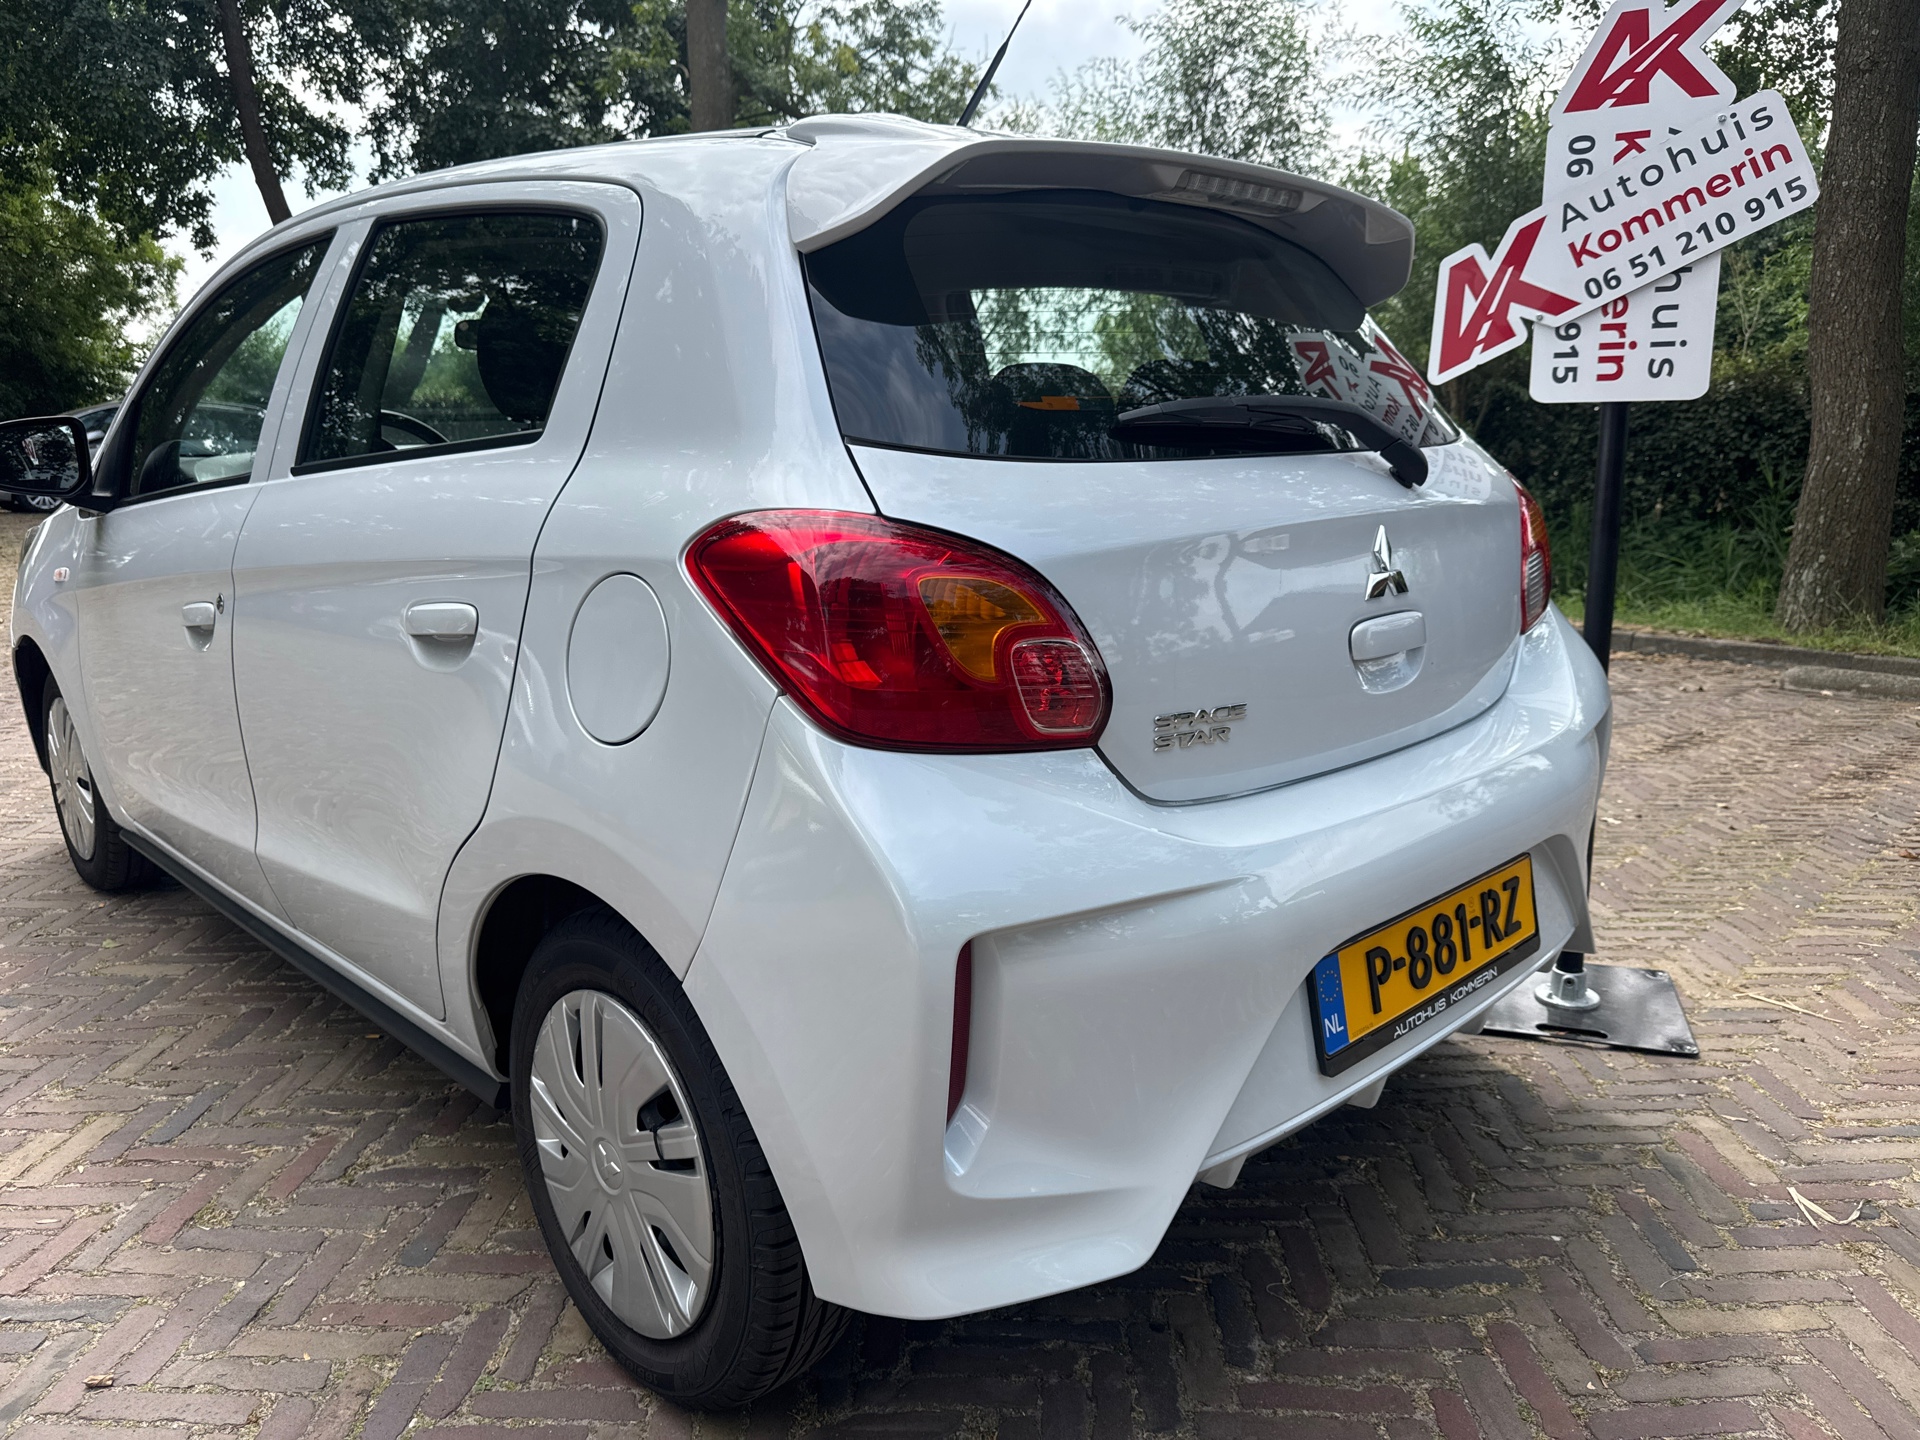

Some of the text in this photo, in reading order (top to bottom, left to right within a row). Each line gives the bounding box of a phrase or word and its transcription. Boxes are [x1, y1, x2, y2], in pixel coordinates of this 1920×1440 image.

[1560, 106, 1774, 233] Autohuis
[1566, 134, 1596, 178] 06
[1567, 143, 1793, 268] Kommerin
[1584, 175, 1808, 299] 06 51 210 915
[1153, 702, 1248, 732] SPACE
[1153, 726, 1231, 752] STAR
[1365, 876, 1522, 1015] P-881-RZ
[1324, 1012, 1345, 1039] NL
[1394, 999, 1447, 1040] AUTOHUIS
[1450, 965, 1499, 1005] KOMMERIN
